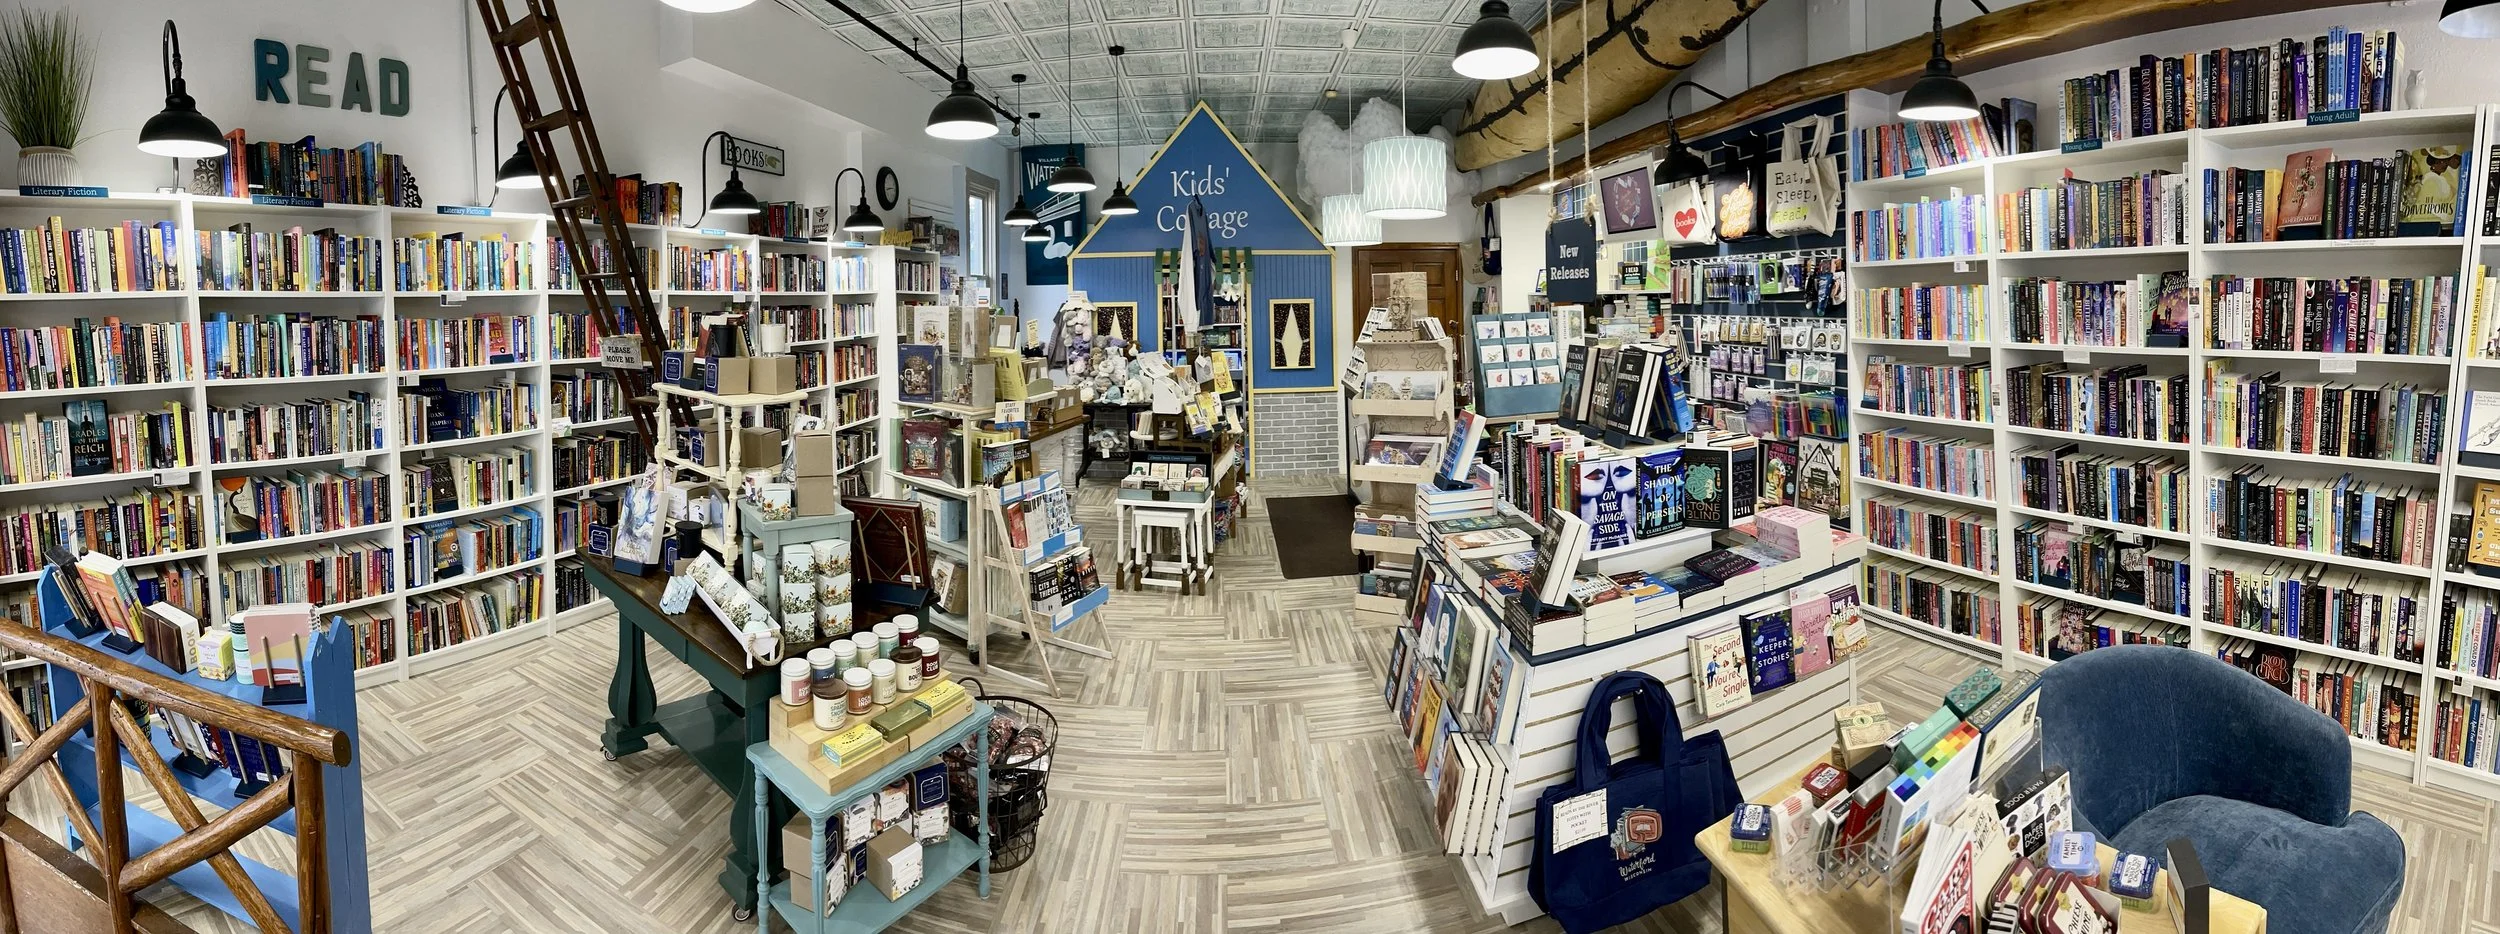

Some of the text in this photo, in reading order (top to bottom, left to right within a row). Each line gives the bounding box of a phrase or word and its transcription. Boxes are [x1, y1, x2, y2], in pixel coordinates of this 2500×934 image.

[255, 39, 409, 116] READ
[2141, 68, 2152, 129] BLOODMARKED
[2310, 111, 2355, 123] Young Adult
[2064, 140, 2098, 152] Young Adult
[726, 140, 764, 168] BOOKS
[1170, 164, 1230, 198] Kids'
[1775, 172, 1803, 185] Eat,
[32, 187, 97, 197] Literary Fiction
[262, 197, 314, 206] Literary Fiction
[2236, 192, 2244, 228] TIME TELL
[1156, 205, 1249, 239] Coage
[1676, 215, 1695, 228] books
[1560, 245, 1579, 259] New
[1550, 266, 1590, 280] Releases
[2474, 288, 2482, 318] BIRDING
[2305, 304, 2313, 327] twilight
[2438, 305, 2448, 332] loveless
[110, 322, 119, 350] BROOKS
[608, 346, 631, 354] PLEASE
[1595, 382, 1609, 393] LOVE
[71, 428, 106, 438] CRADLES
[74, 444, 104, 454] REICH
[1768, 451, 1796, 465] STICKER
[1655, 463, 1672, 474] THE
[1644, 475, 1683, 490] SHADOW
[1603, 491, 1617, 501] ON
[1600, 502, 1618, 513] THE
[1646, 504, 1682, 521] PERSEUS
[1687, 502, 1720, 512] STONE
[1594, 511, 1625, 524] SAVAGE
[1599, 525, 1620, 535] SIDE
[1663, 522, 1683, 531] HEYWOOD
[1039, 581, 1050, 590] CITY
[1040, 586, 1058, 598] THIEVES
[1832, 598, 1846, 614] LOVE
[189, 628, 198, 665] BOOK
[1713, 635, 1741, 657] Second
[1759, 640, 1787, 654] KEEPER
[1758, 652, 1790, 668] STORIES
[2471, 659, 2476, 668] DO
[1713, 670, 1737, 686] You're
[1723, 678, 1748, 699] Single
[2381, 708, 2389, 734] SAINT
[2003, 780, 2044, 808] PAPER DOGS
[1586, 801, 1599, 809] RIVER
[1570, 820, 1587, 829] POCKET
[2024, 822, 2044, 840] PAPER
[2025, 830, 2044, 848] DOGS
[1618, 852, 1656, 877] Waterford
[1624, 867, 1652, 882] WISCONSIN
